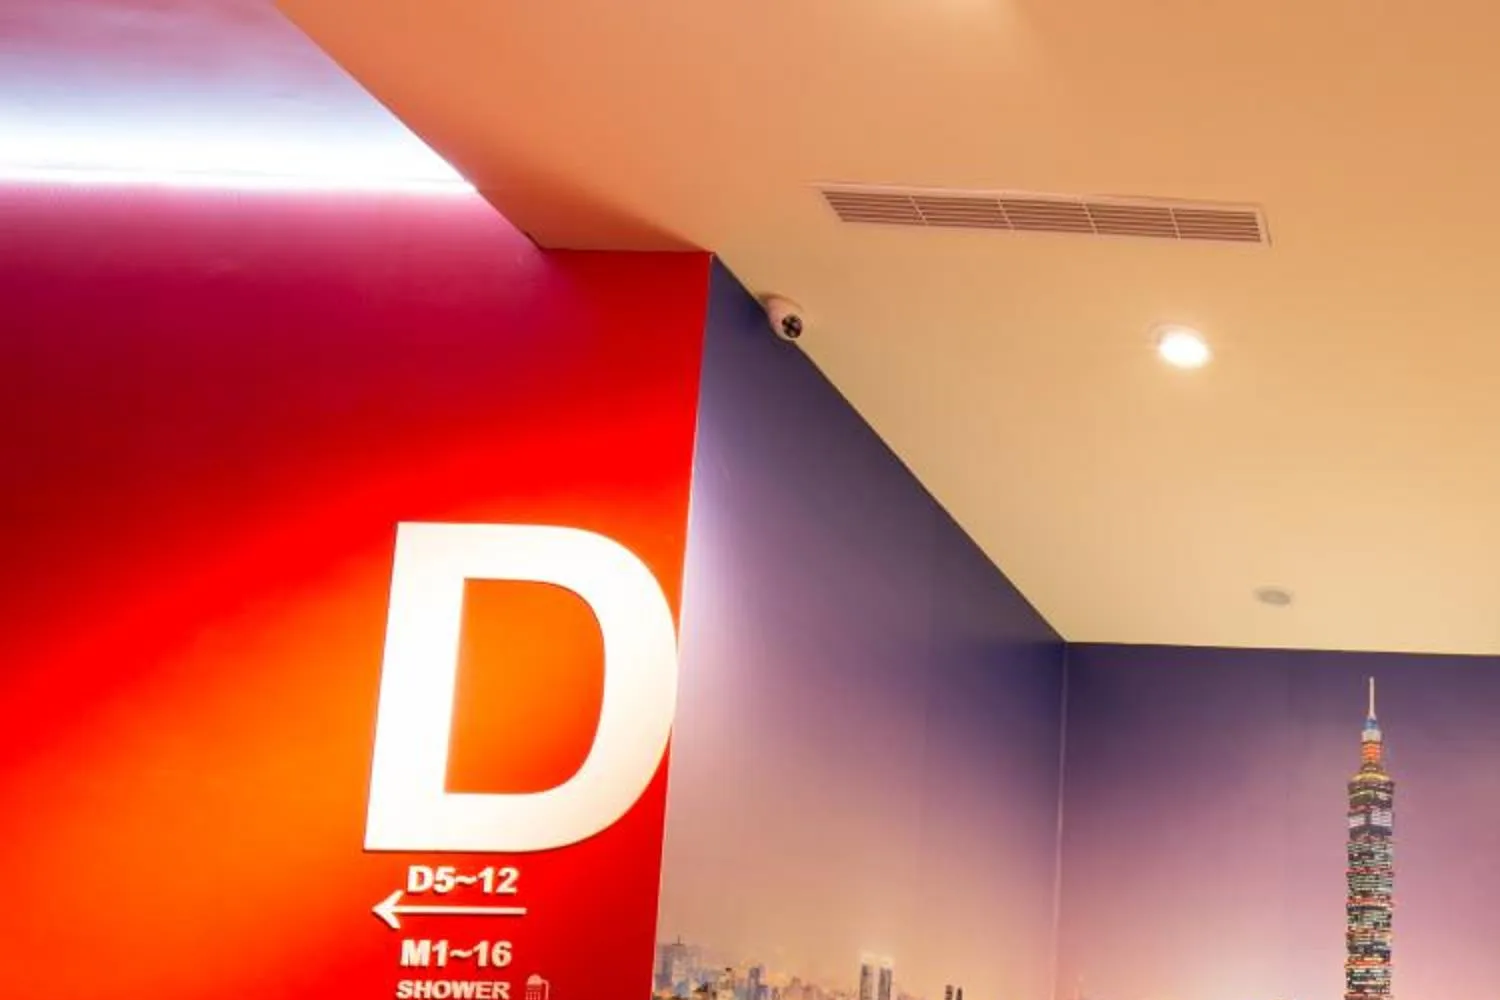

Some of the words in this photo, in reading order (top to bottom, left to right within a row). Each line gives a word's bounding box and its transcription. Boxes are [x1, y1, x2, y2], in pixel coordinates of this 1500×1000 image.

[363, 521, 679, 852] D
[407, 865, 519, 894] D5~12
[401, 939, 513, 968] M1~16
[396, 979, 511, 1000] SHOWER
